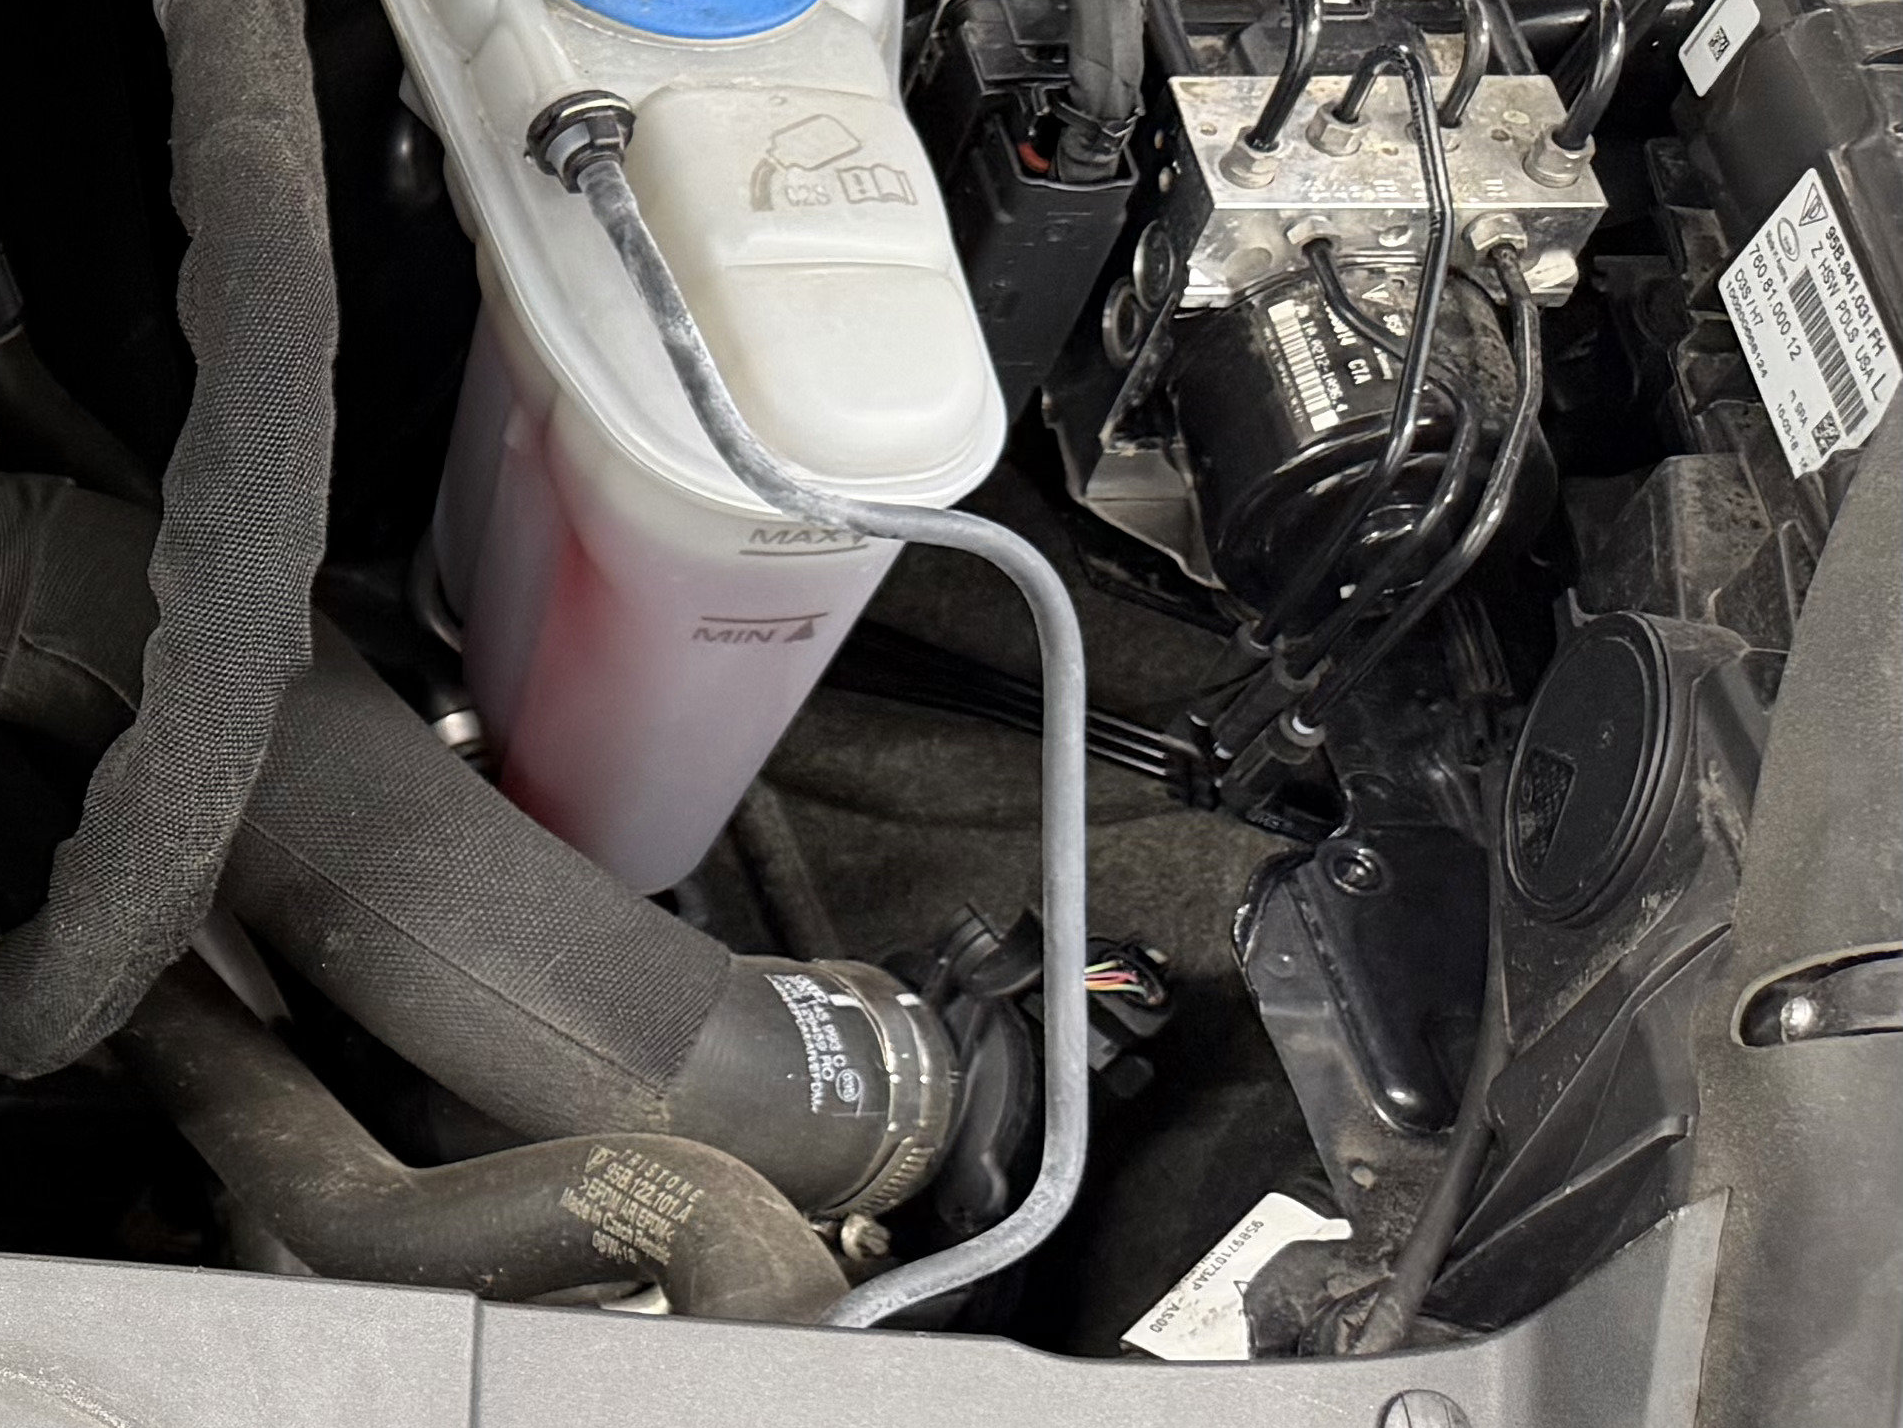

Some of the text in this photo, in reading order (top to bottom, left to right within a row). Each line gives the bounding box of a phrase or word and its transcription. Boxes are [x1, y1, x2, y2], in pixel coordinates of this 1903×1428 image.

[1748, 304, 1764, 327] H7
[1811, 241, 1874, 384] Z HSW PDLS USA
[1823, 225, 1886, 402] 95B.941.031.FH L
[1346, 356, 1372, 385] CTA
[748, 528, 846, 545] MAX
[692, 628, 778, 644] MIN
[601, 1159, 694, 1224] 95B.122.101.A
[618, 1147, 705, 1203] TRISTONE
